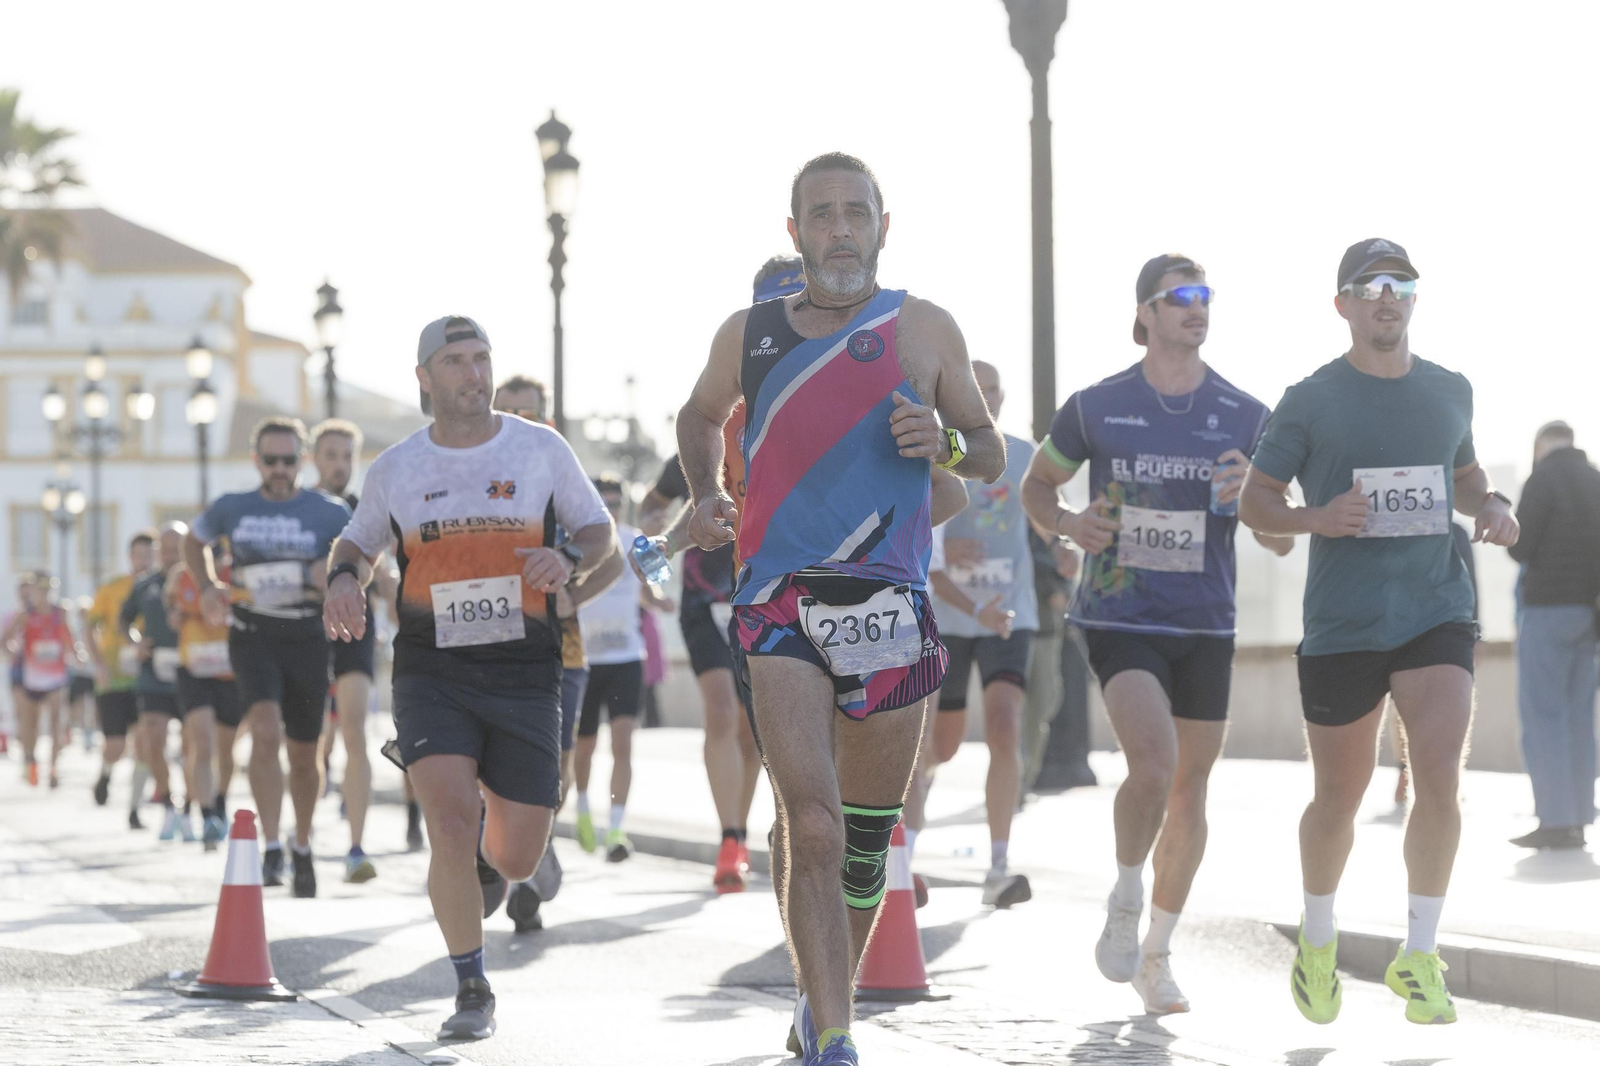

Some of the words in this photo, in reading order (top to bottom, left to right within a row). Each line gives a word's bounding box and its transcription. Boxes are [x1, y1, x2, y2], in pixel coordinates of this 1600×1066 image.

[750, 347, 779, 358] VIATOR
[1111, 458, 1132, 475] EL
[1134, 461, 1212, 482] PUERTO
[1368, 487, 1434, 513] 1653
[442, 516, 525, 530] RUBYSAN
[1132, 526, 1193, 550] 1082
[446, 597, 510, 624] 1893
[818, 609, 900, 649] 2367
